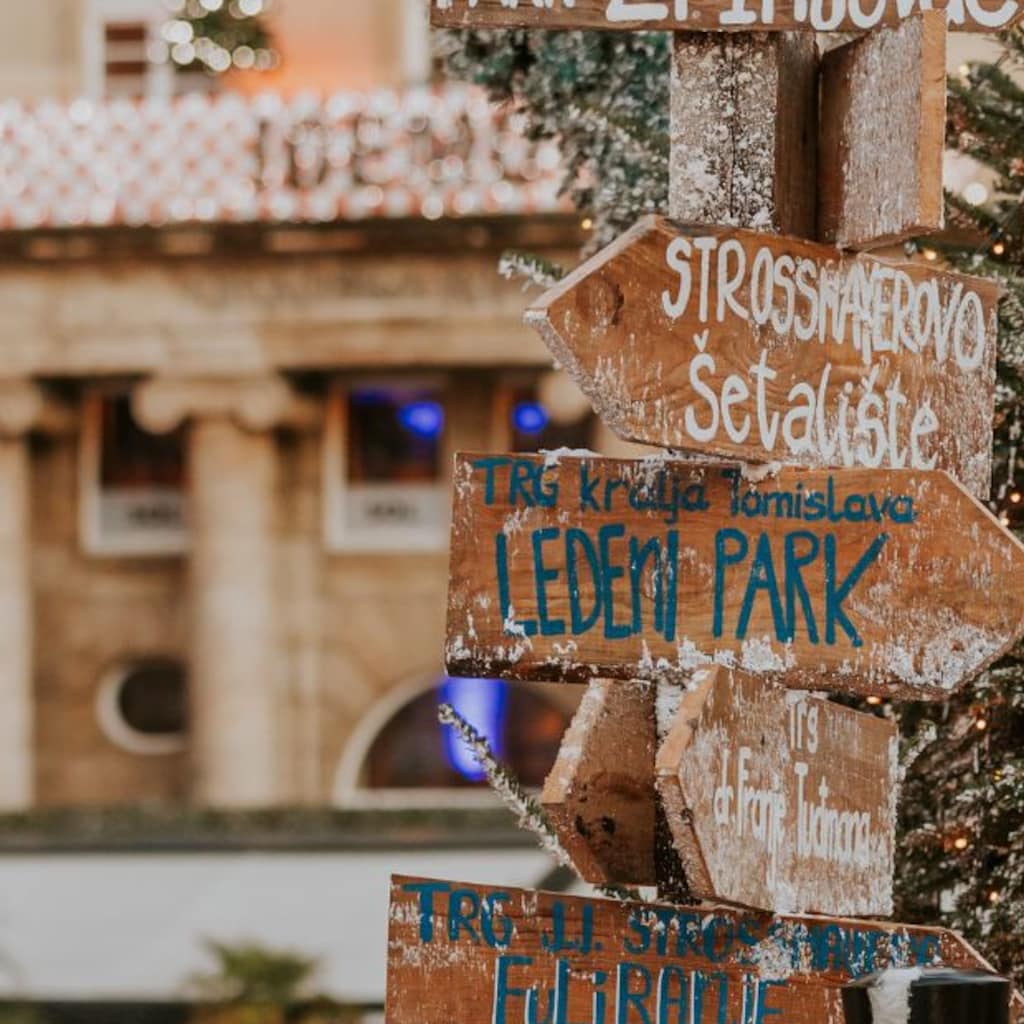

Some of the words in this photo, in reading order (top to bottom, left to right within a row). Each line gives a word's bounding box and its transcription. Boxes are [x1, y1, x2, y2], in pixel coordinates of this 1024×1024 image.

[473, 457, 559, 507] TRG
[720, 467, 918, 524] Tomislava
[713, 527, 888, 647] PARK
[402, 881, 514, 948] TRG
